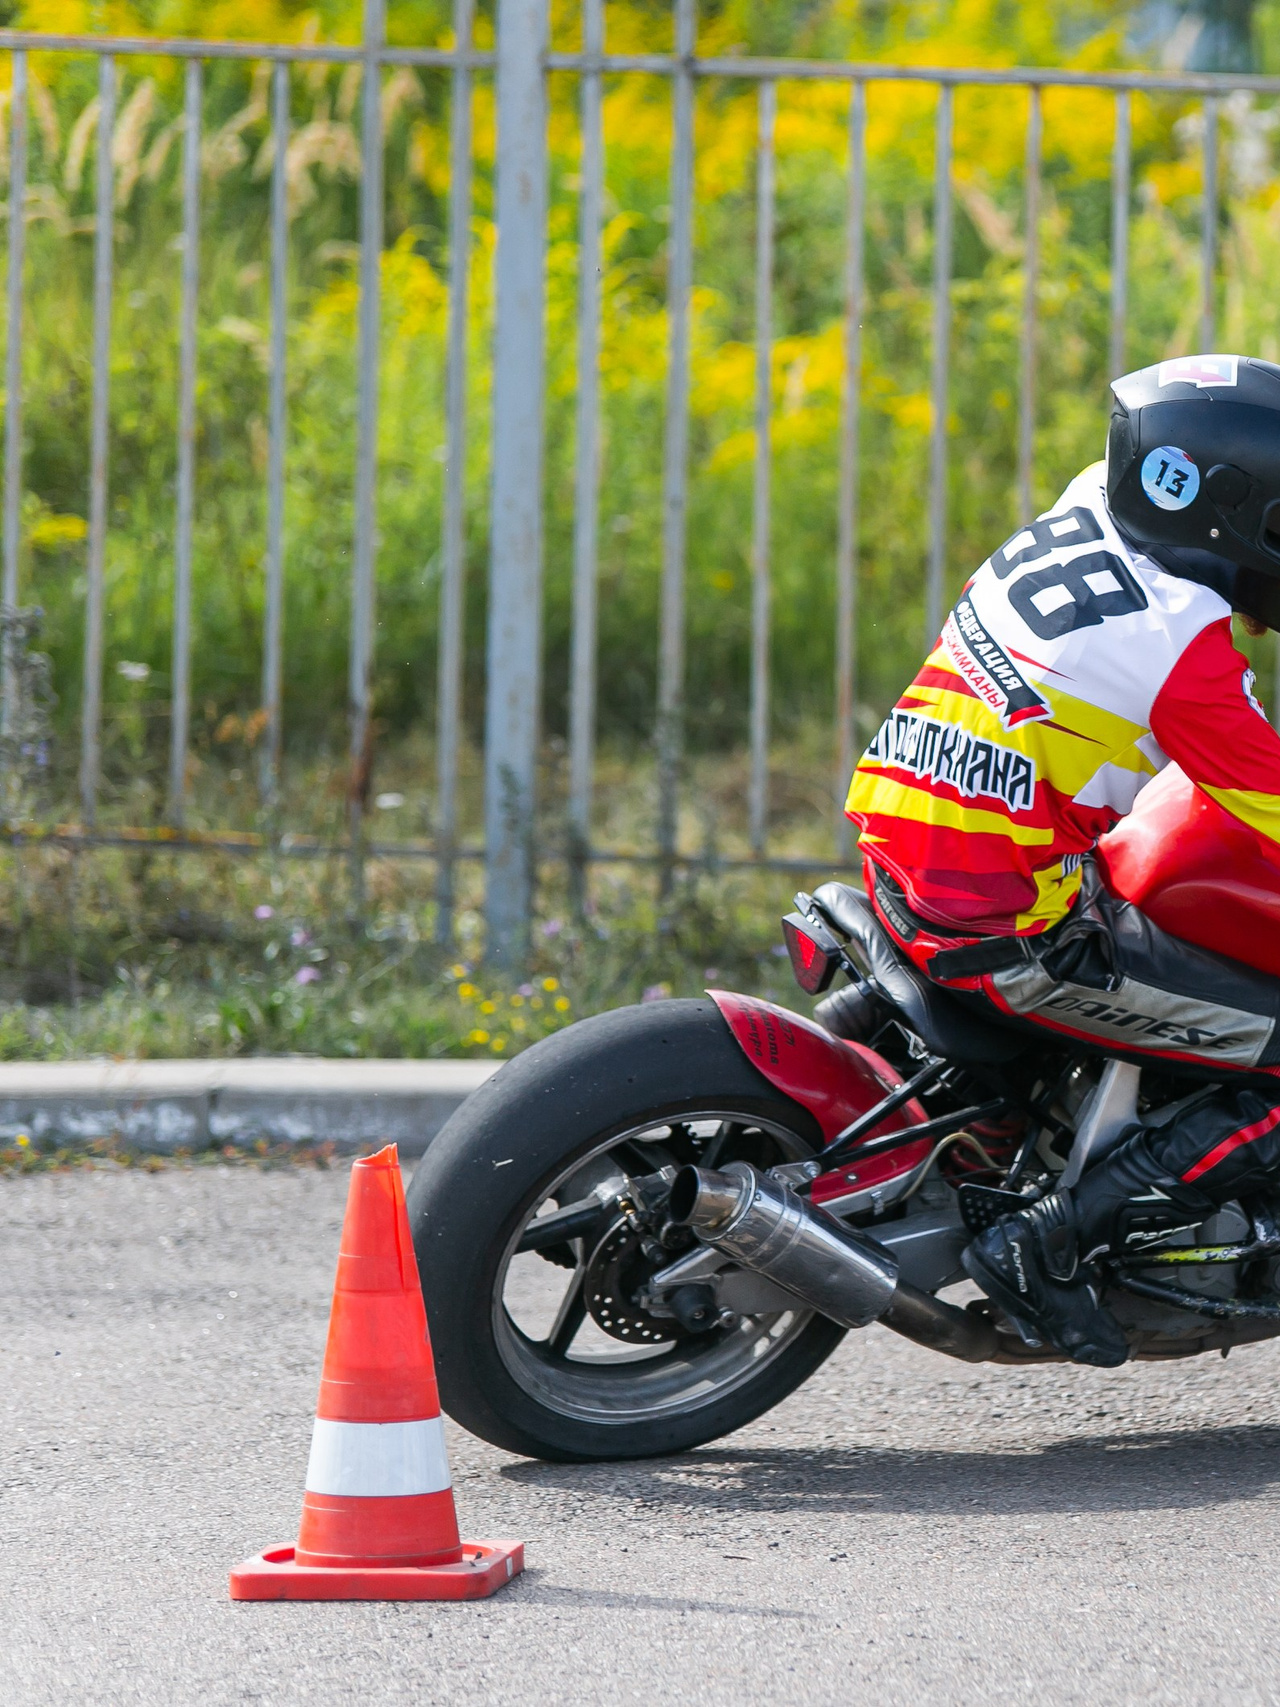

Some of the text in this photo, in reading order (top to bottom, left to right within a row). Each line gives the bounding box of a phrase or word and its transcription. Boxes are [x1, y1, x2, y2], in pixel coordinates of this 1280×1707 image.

[1156, 459, 1190, 500] 13
[989, 506, 1149, 641] 88
[956, 601, 1024, 692] ФЕДЕРАЦИЯ
